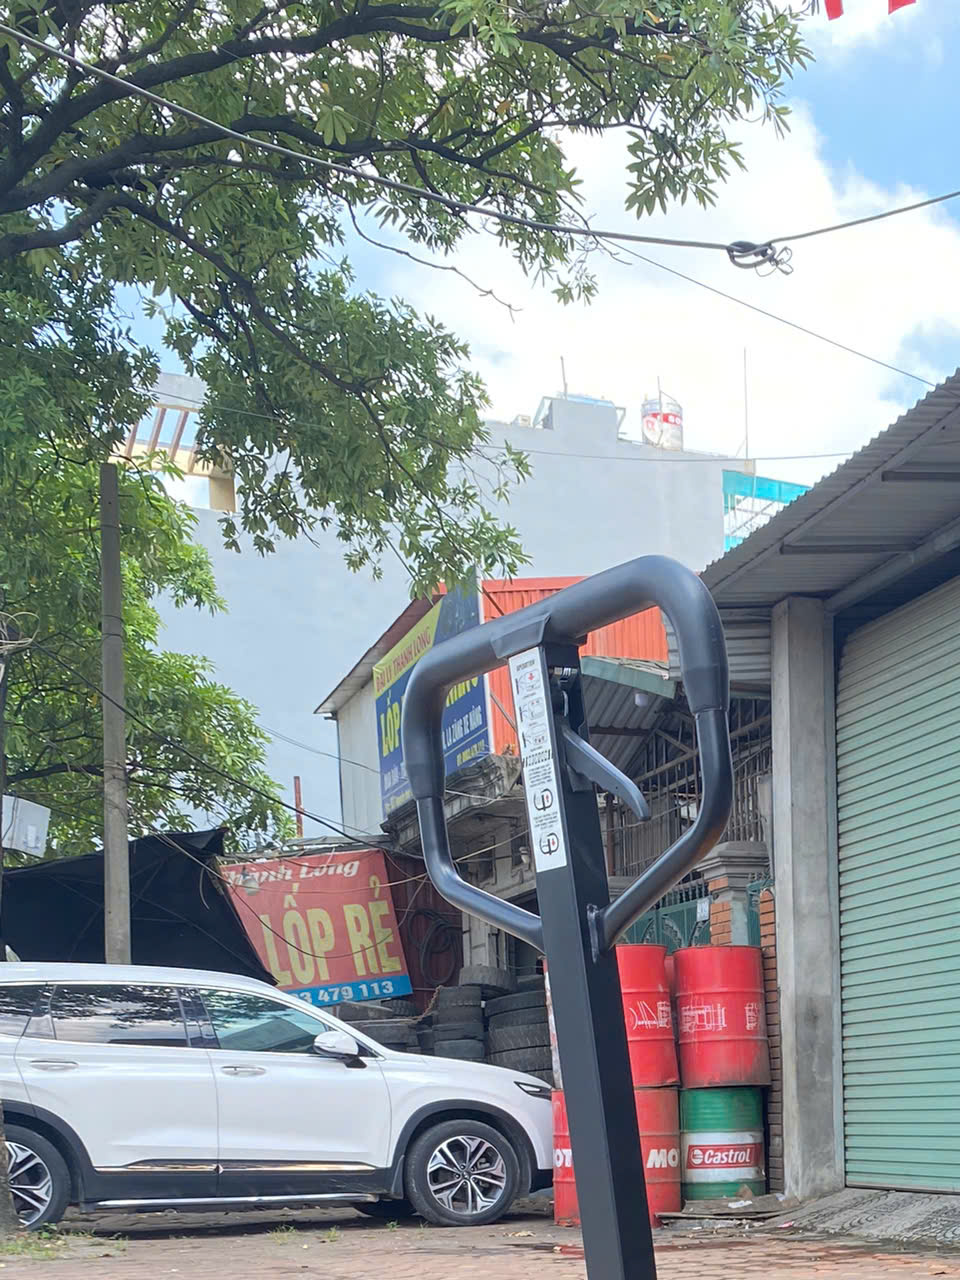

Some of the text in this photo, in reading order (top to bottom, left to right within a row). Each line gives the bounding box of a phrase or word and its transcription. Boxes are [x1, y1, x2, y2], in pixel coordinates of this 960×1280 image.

[261, 875, 402, 988] LỐP RẺ
[318, 985, 355, 1003] 479
[358, 980, 395, 998] 113
[702, 1149, 751, 1165] Castrol
